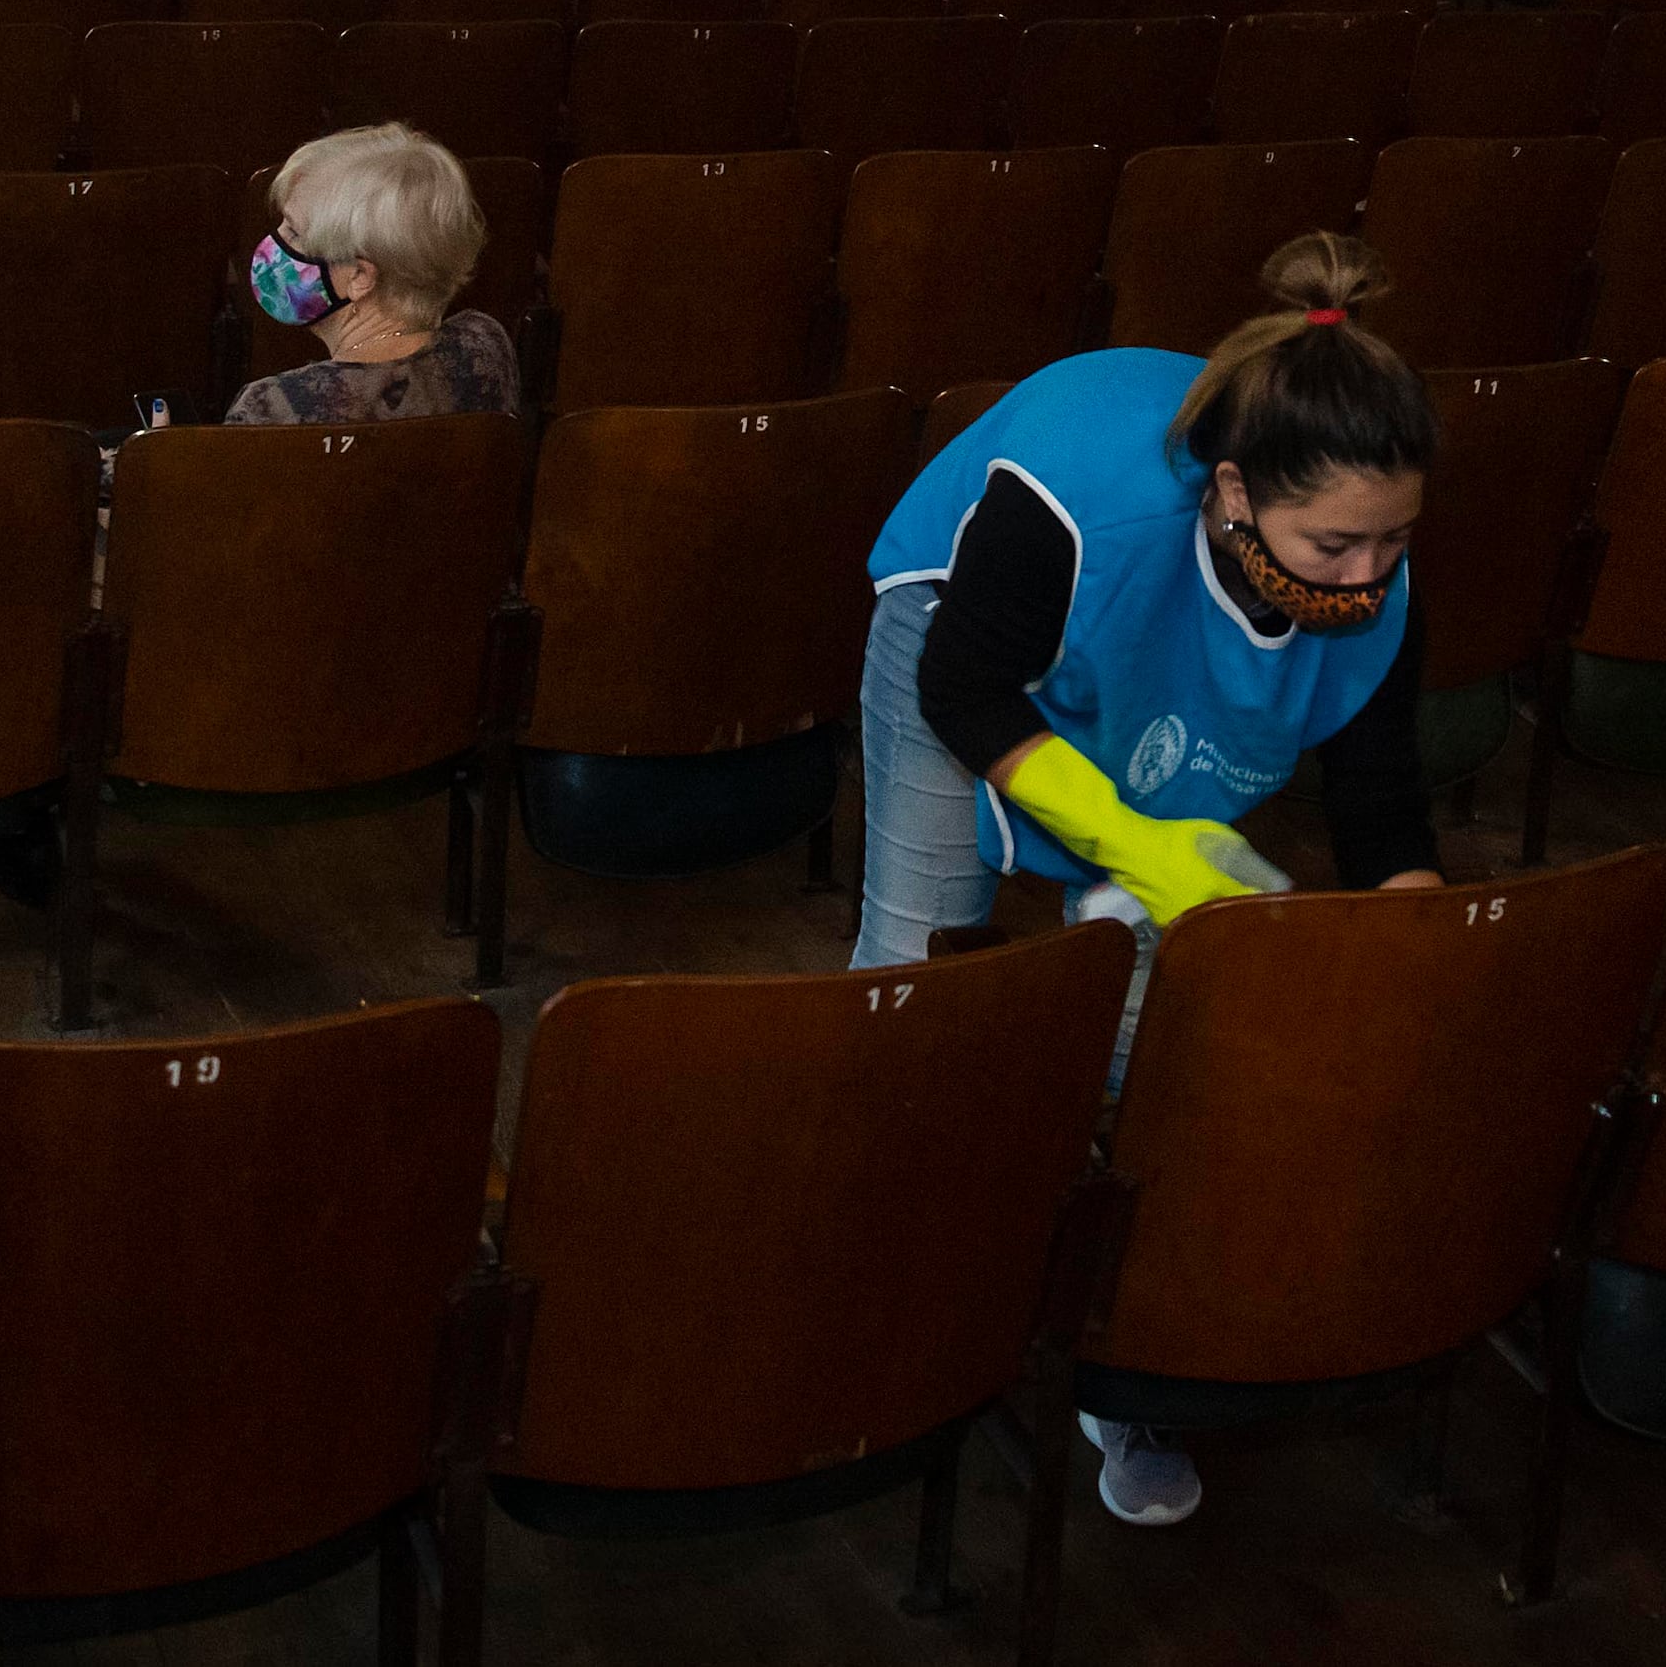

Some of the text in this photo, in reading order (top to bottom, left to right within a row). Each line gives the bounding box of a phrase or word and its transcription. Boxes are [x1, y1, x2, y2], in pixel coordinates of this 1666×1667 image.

[201, 29, 221, 41] 15
[451, 29, 470, 40] 13
[693, 28, 711, 40] 11
[702, 162, 725, 177] 13
[990, 159, 1011, 173] 11
[68, 180, 93, 196] 17
[1474, 378, 1498, 395] 11
[740, 415, 769, 434] 15
[322, 435, 355, 454] 17
[1189, 754, 1215, 773] de
[1466, 897, 1507, 926] 15
[867, 984, 914, 1012] 17
[166, 1056, 221, 1087] 19
